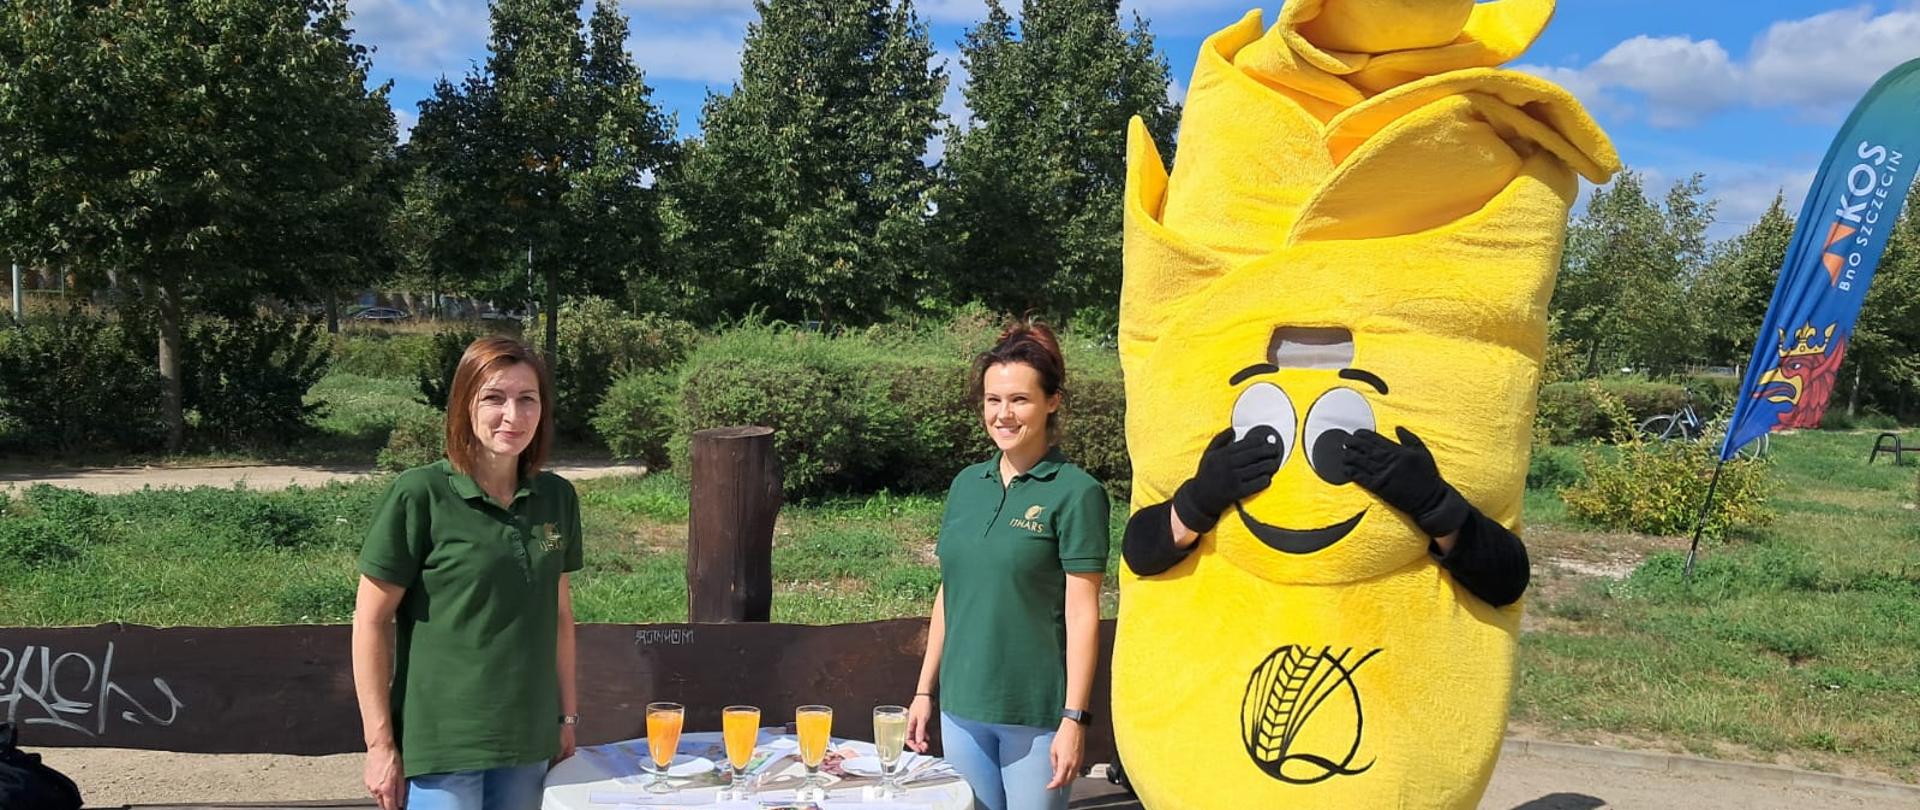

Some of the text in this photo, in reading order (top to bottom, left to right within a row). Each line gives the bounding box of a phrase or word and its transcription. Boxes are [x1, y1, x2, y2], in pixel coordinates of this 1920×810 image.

[1836, 141, 1887, 223] KOS
[1839, 150, 1903, 291] BnO SZCZECIN
